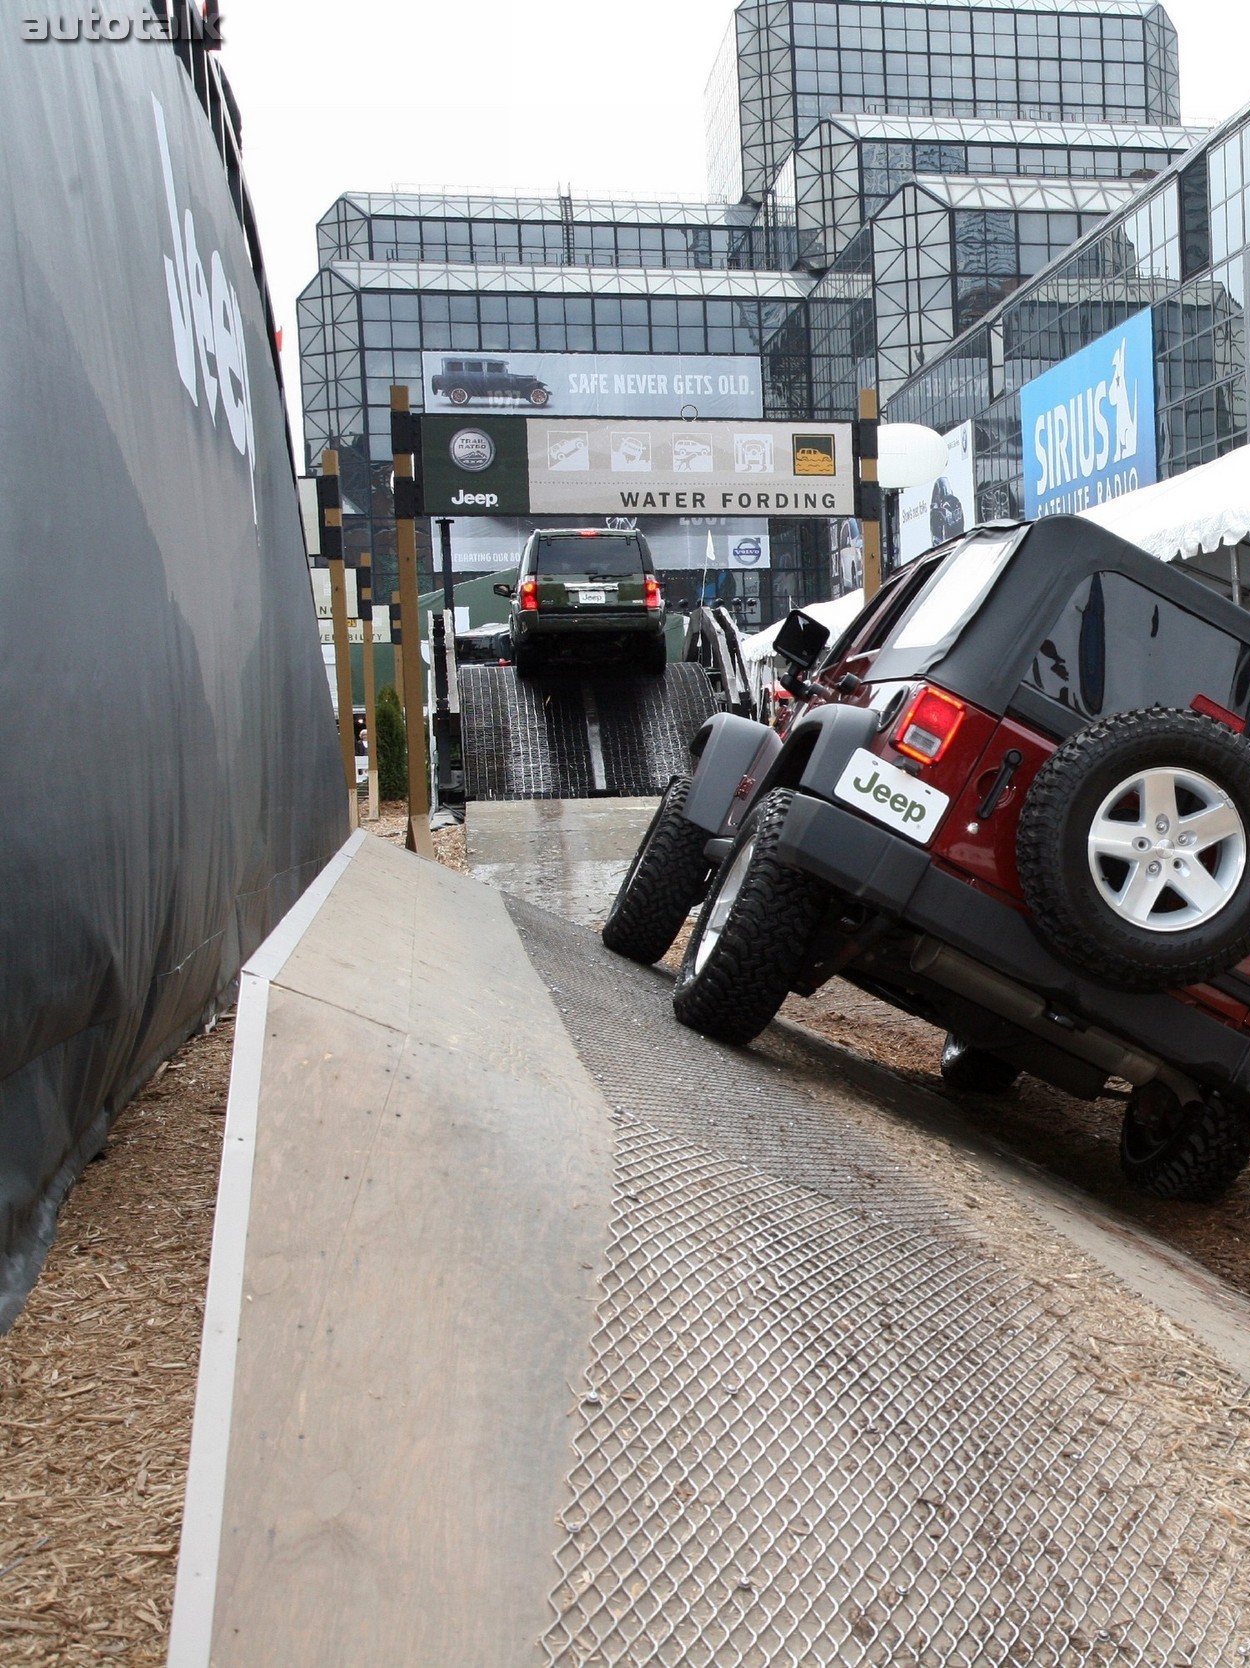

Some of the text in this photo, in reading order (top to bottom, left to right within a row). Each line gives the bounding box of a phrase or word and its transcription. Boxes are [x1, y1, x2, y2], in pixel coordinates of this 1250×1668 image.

[568, 373, 755, 396] SAFE NEVER GETS OLD.
[1034, 380, 1109, 496] SIRIUS
[1097, 466, 1138, 505] RADIO
[451, 489, 498, 508] Jeep
[619, 491, 836, 509] WATER FORDING
[582, 592, 603, 601] Jeep
[852, 771, 927, 823] Jeep
